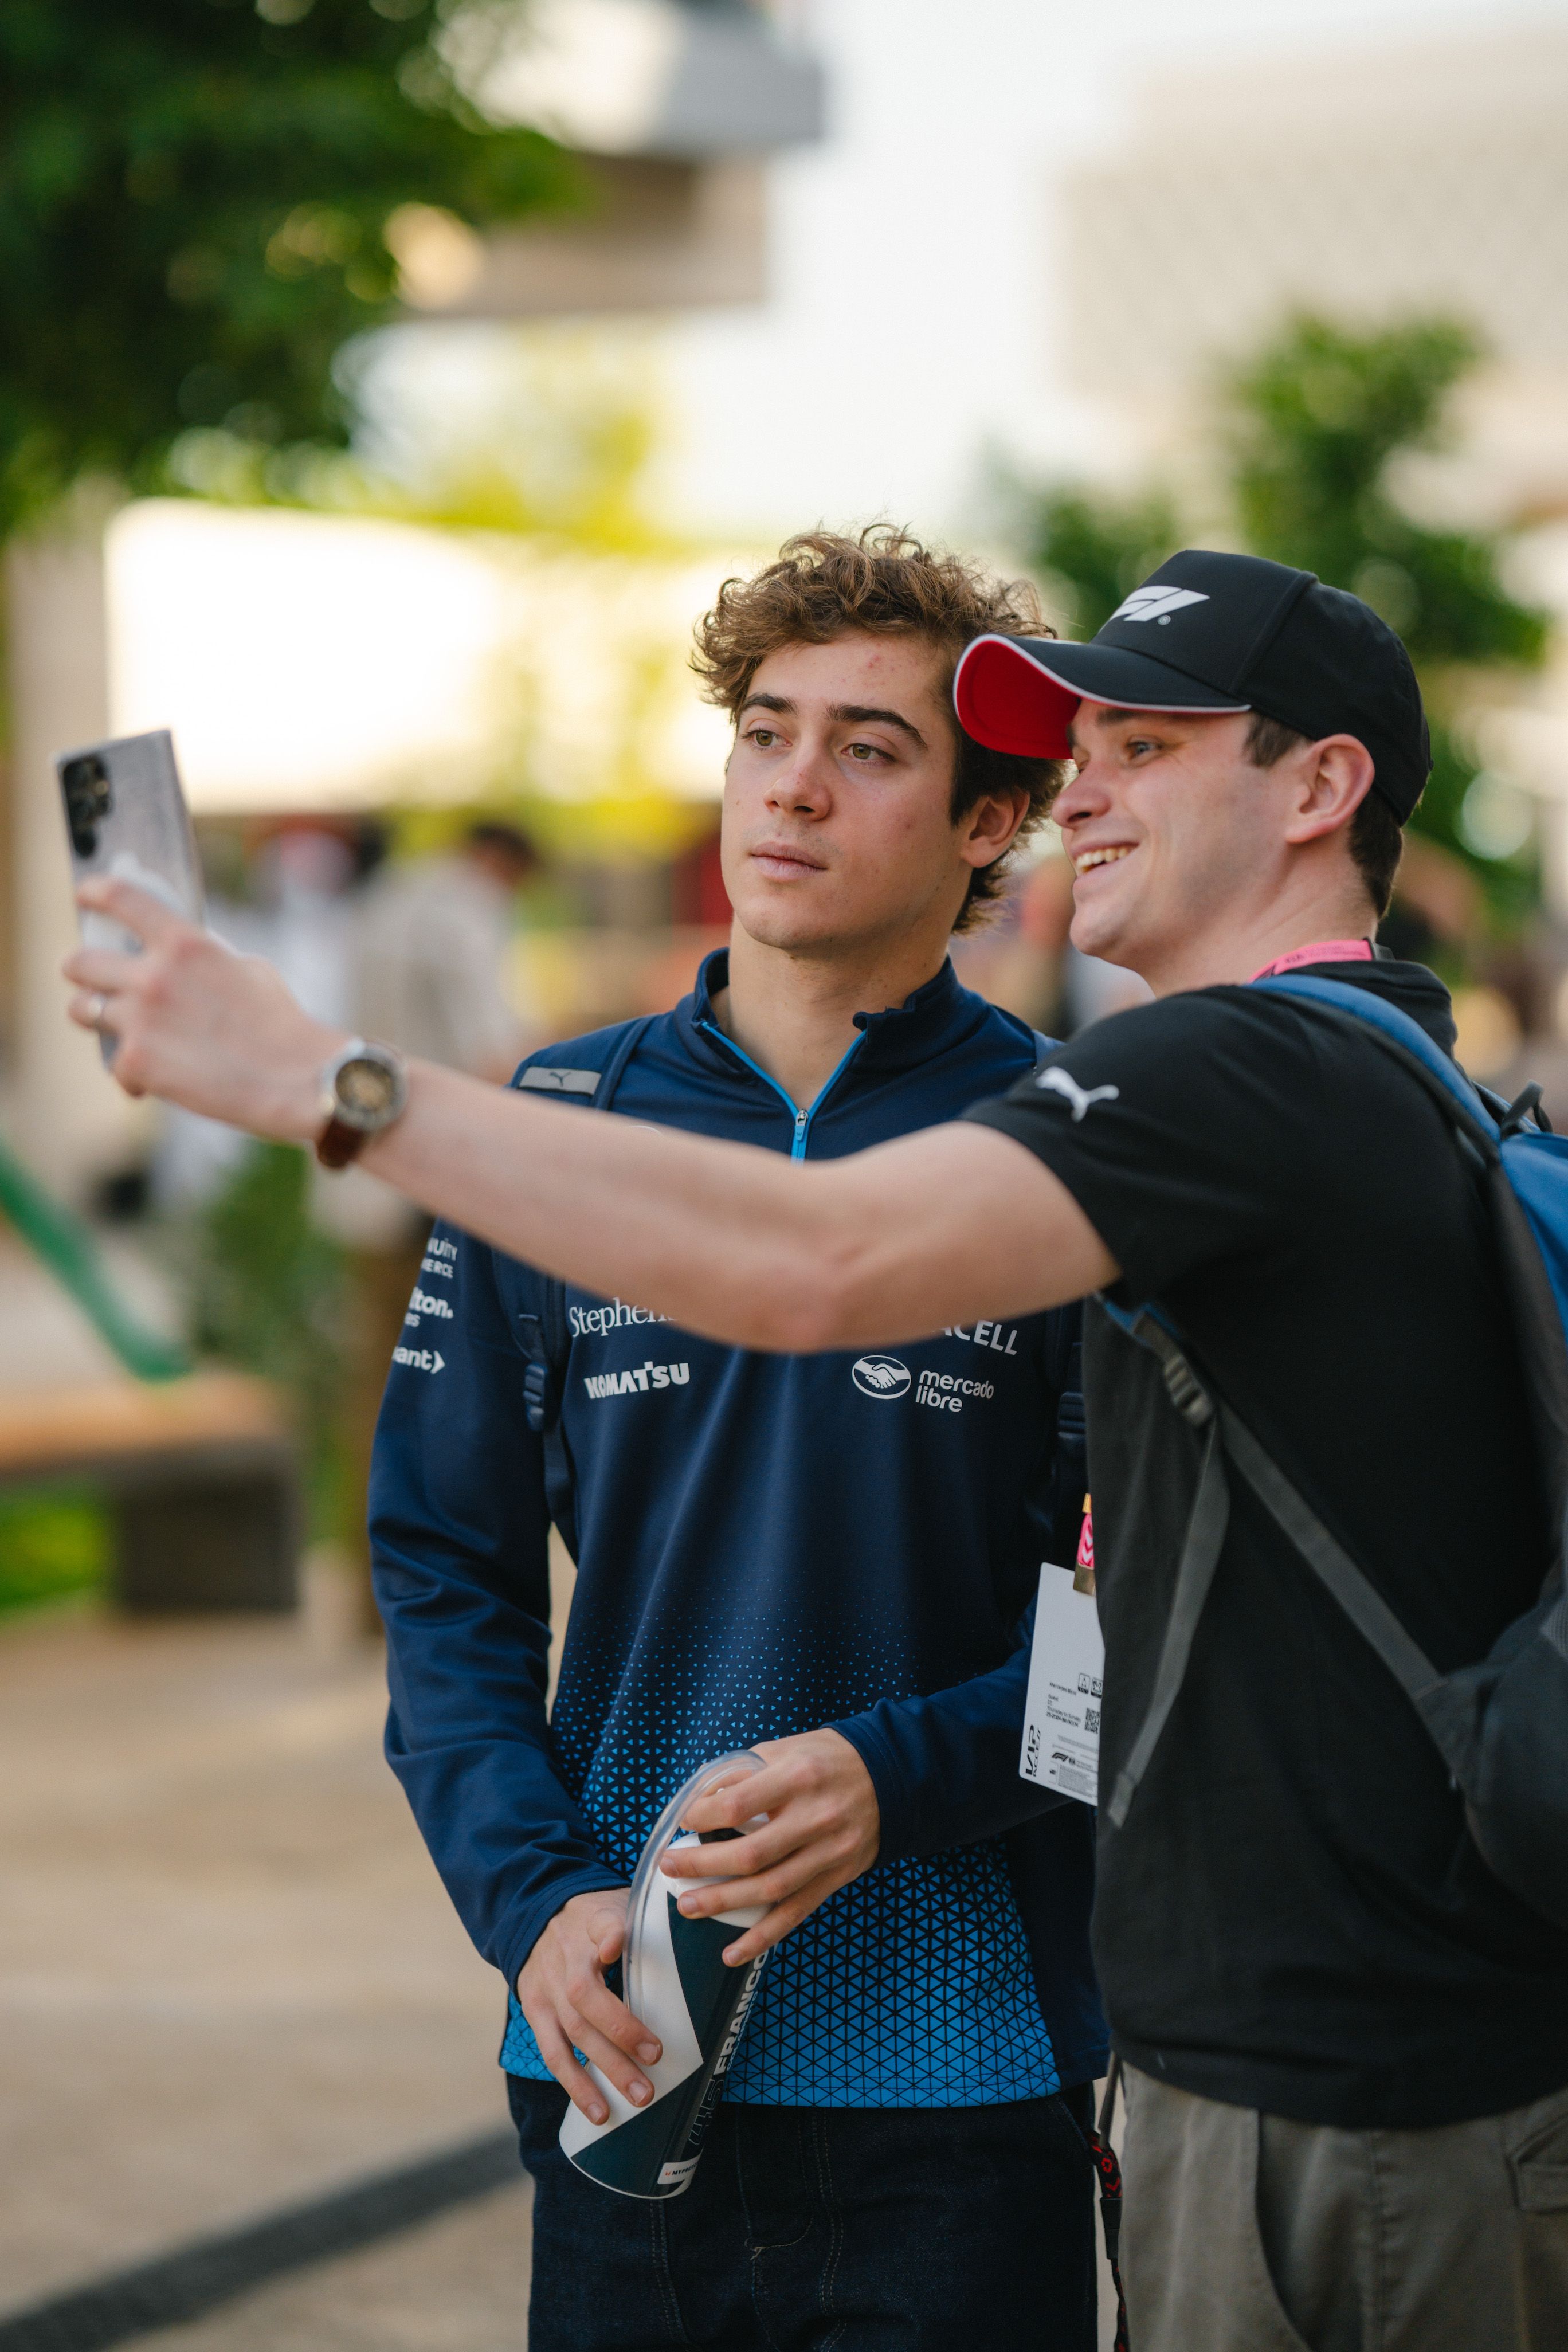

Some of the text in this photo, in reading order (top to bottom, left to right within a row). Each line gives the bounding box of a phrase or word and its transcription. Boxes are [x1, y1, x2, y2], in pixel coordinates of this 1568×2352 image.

[569, 1297, 677, 1338] Stephen
[583, 1361, 690, 1400] KOMATSU
[915, 1385, 963, 1413] libre
[919, 1370, 995, 1400] mercado
[1025, 1724, 1036, 1775] VIP
[713, 1949, 769, 2075] FRANCO
